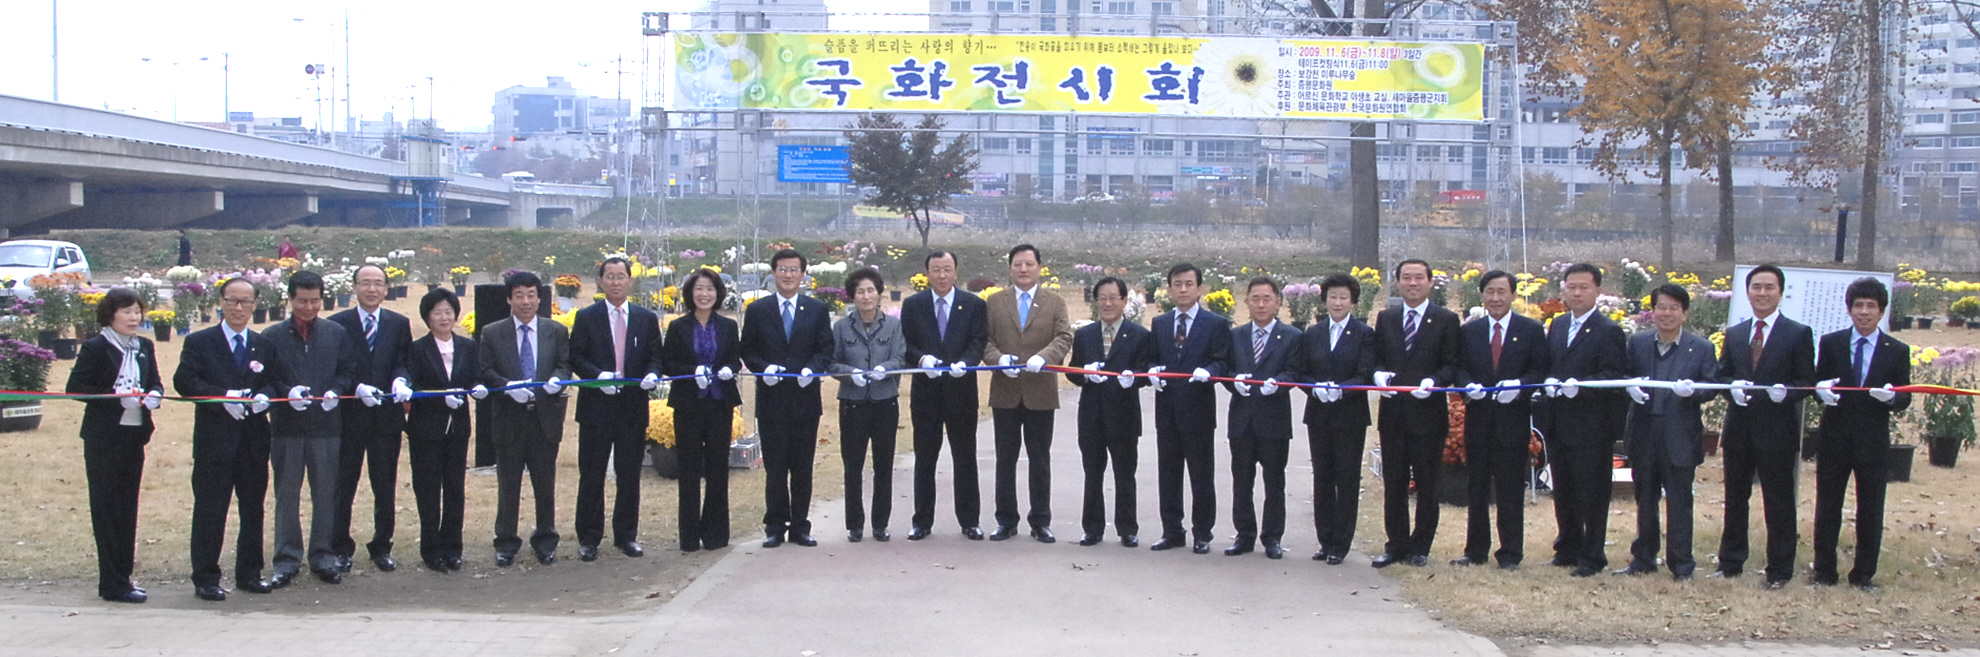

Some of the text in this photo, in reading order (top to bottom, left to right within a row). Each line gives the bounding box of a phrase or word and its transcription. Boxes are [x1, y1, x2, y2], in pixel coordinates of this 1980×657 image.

[824, 38, 859, 54] 슬픔을
[920, 39, 954, 54] 사랑의
[1278, 47, 1293, 57] 일시
[1403, 49, 1422, 59] 3일간
[1278, 69, 1291, 79] 장소
[1299, 70, 1319, 79] 보강천
[1298, 80, 1333, 90] 증평문화원
[1277, 90, 1291, 100] 주관
[1298, 91, 1319, 101] 어르신
[1321, 91, 1348, 101] 문화학교
[1277, 101, 1291, 112] 후원
[1352, 102, 1407, 113] 한국문화원연합회
